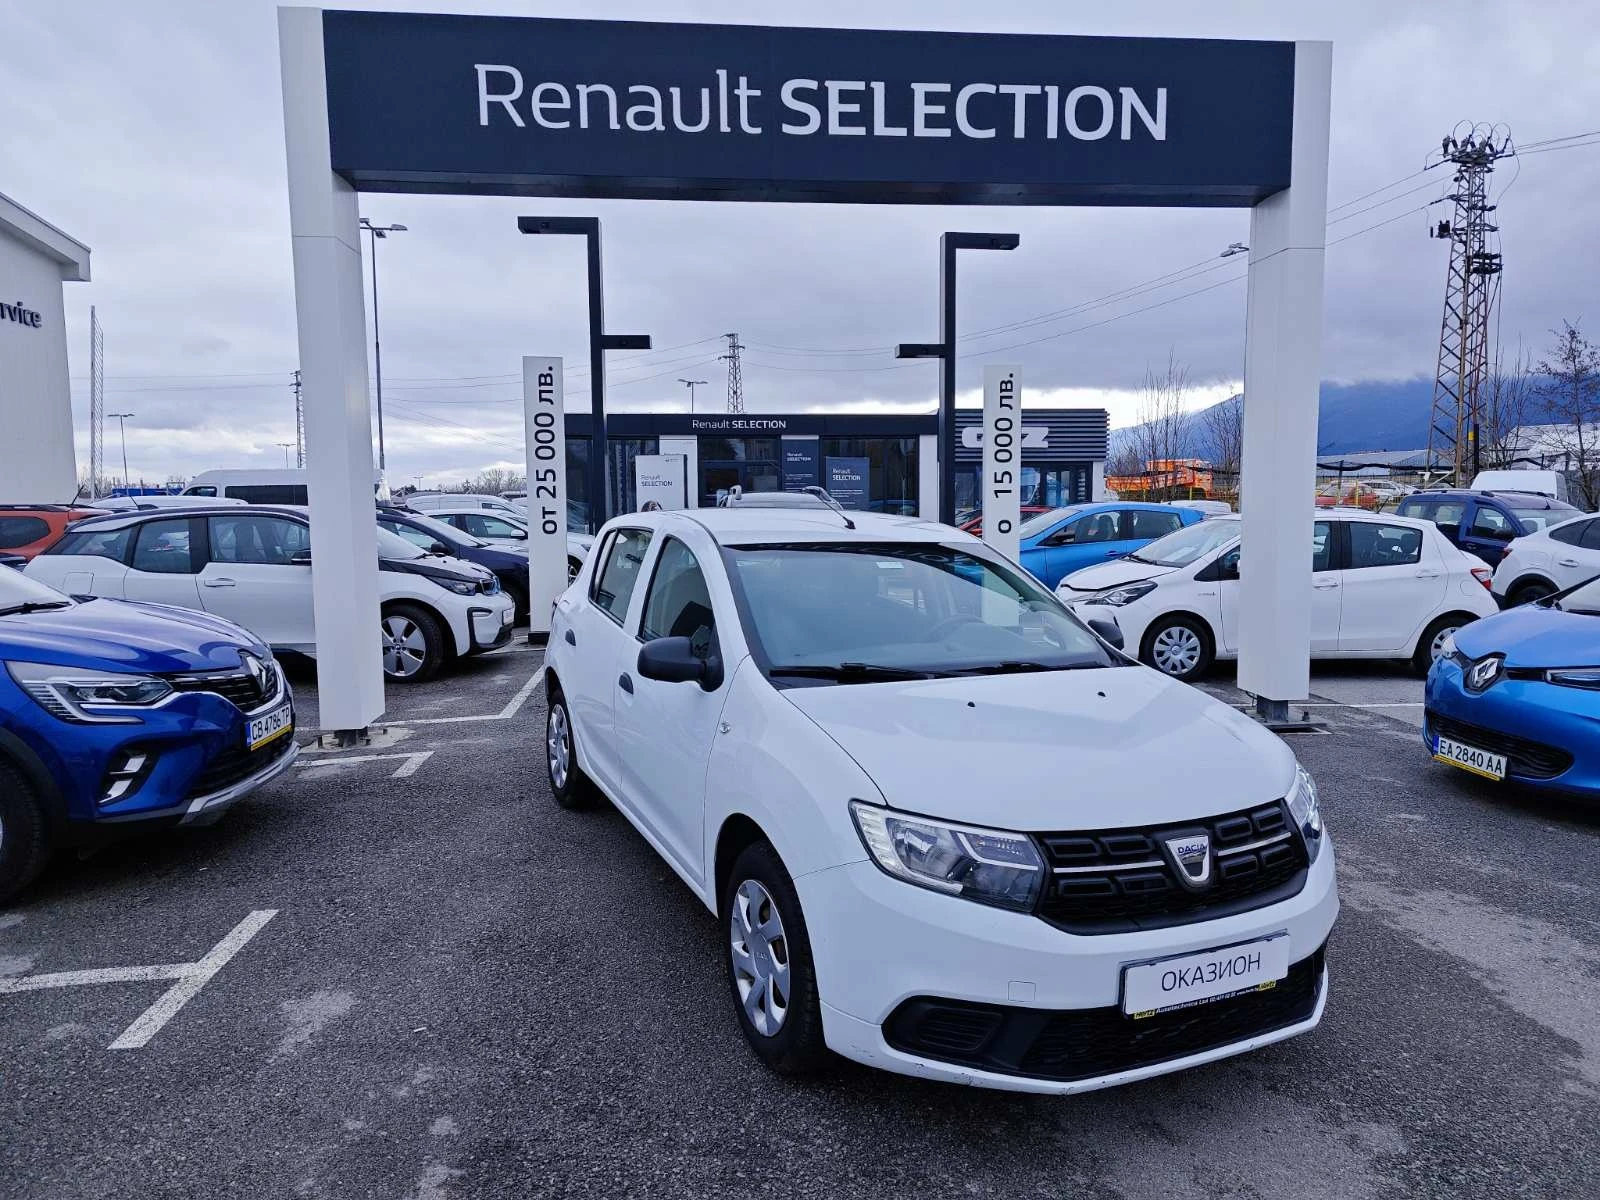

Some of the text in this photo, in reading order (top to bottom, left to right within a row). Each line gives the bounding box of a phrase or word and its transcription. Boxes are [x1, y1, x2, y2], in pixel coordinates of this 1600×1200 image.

[474, 64, 1168, 141] Renault SELECTION
[1000, 373, 1014, 410] лв.
[692, 419, 787, 429] Renault SELECTION
[994, 417, 1013, 463] 000
[534, 366, 558, 535] от 25 000 лв.
[994, 470, 1013, 499] 15
[252, 720, 263, 740] CB
[1439, 739, 1503, 774] EA 2840 AA
[1177, 843, 1208, 854] DACIA
[1161, 951, 1261, 992] ОКАЗИОН
